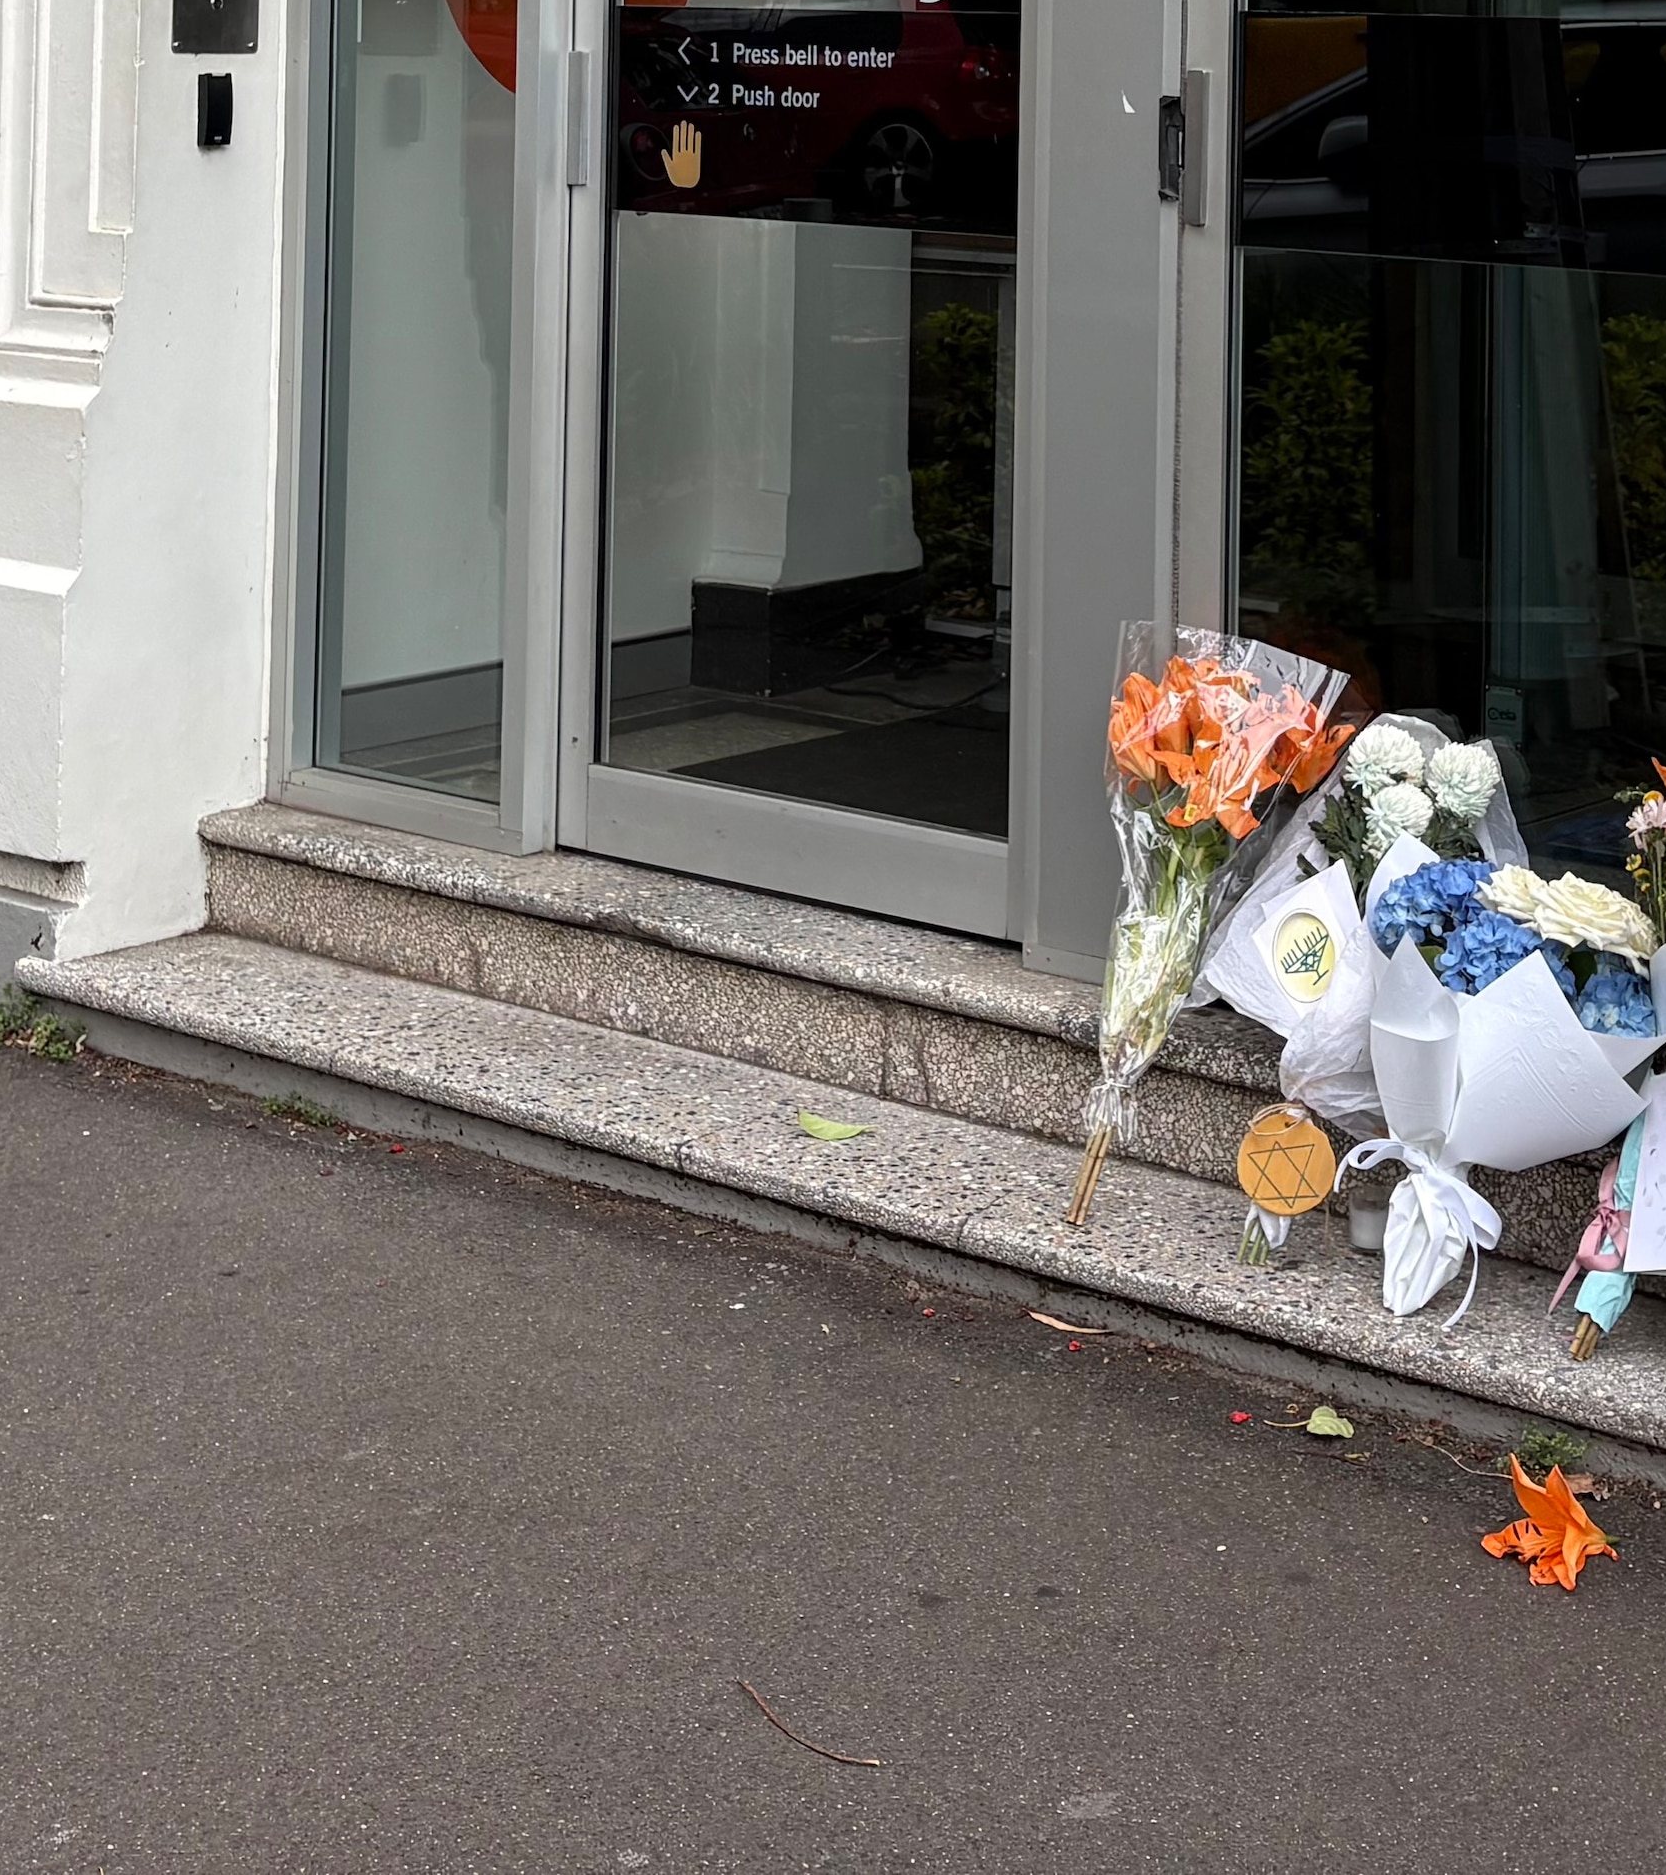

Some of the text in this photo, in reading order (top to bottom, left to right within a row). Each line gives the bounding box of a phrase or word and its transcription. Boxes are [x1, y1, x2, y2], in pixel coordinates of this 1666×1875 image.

[710, 42, 895, 68] 1 Press bell to enter
[708, 83, 820, 108] 2 Push door
